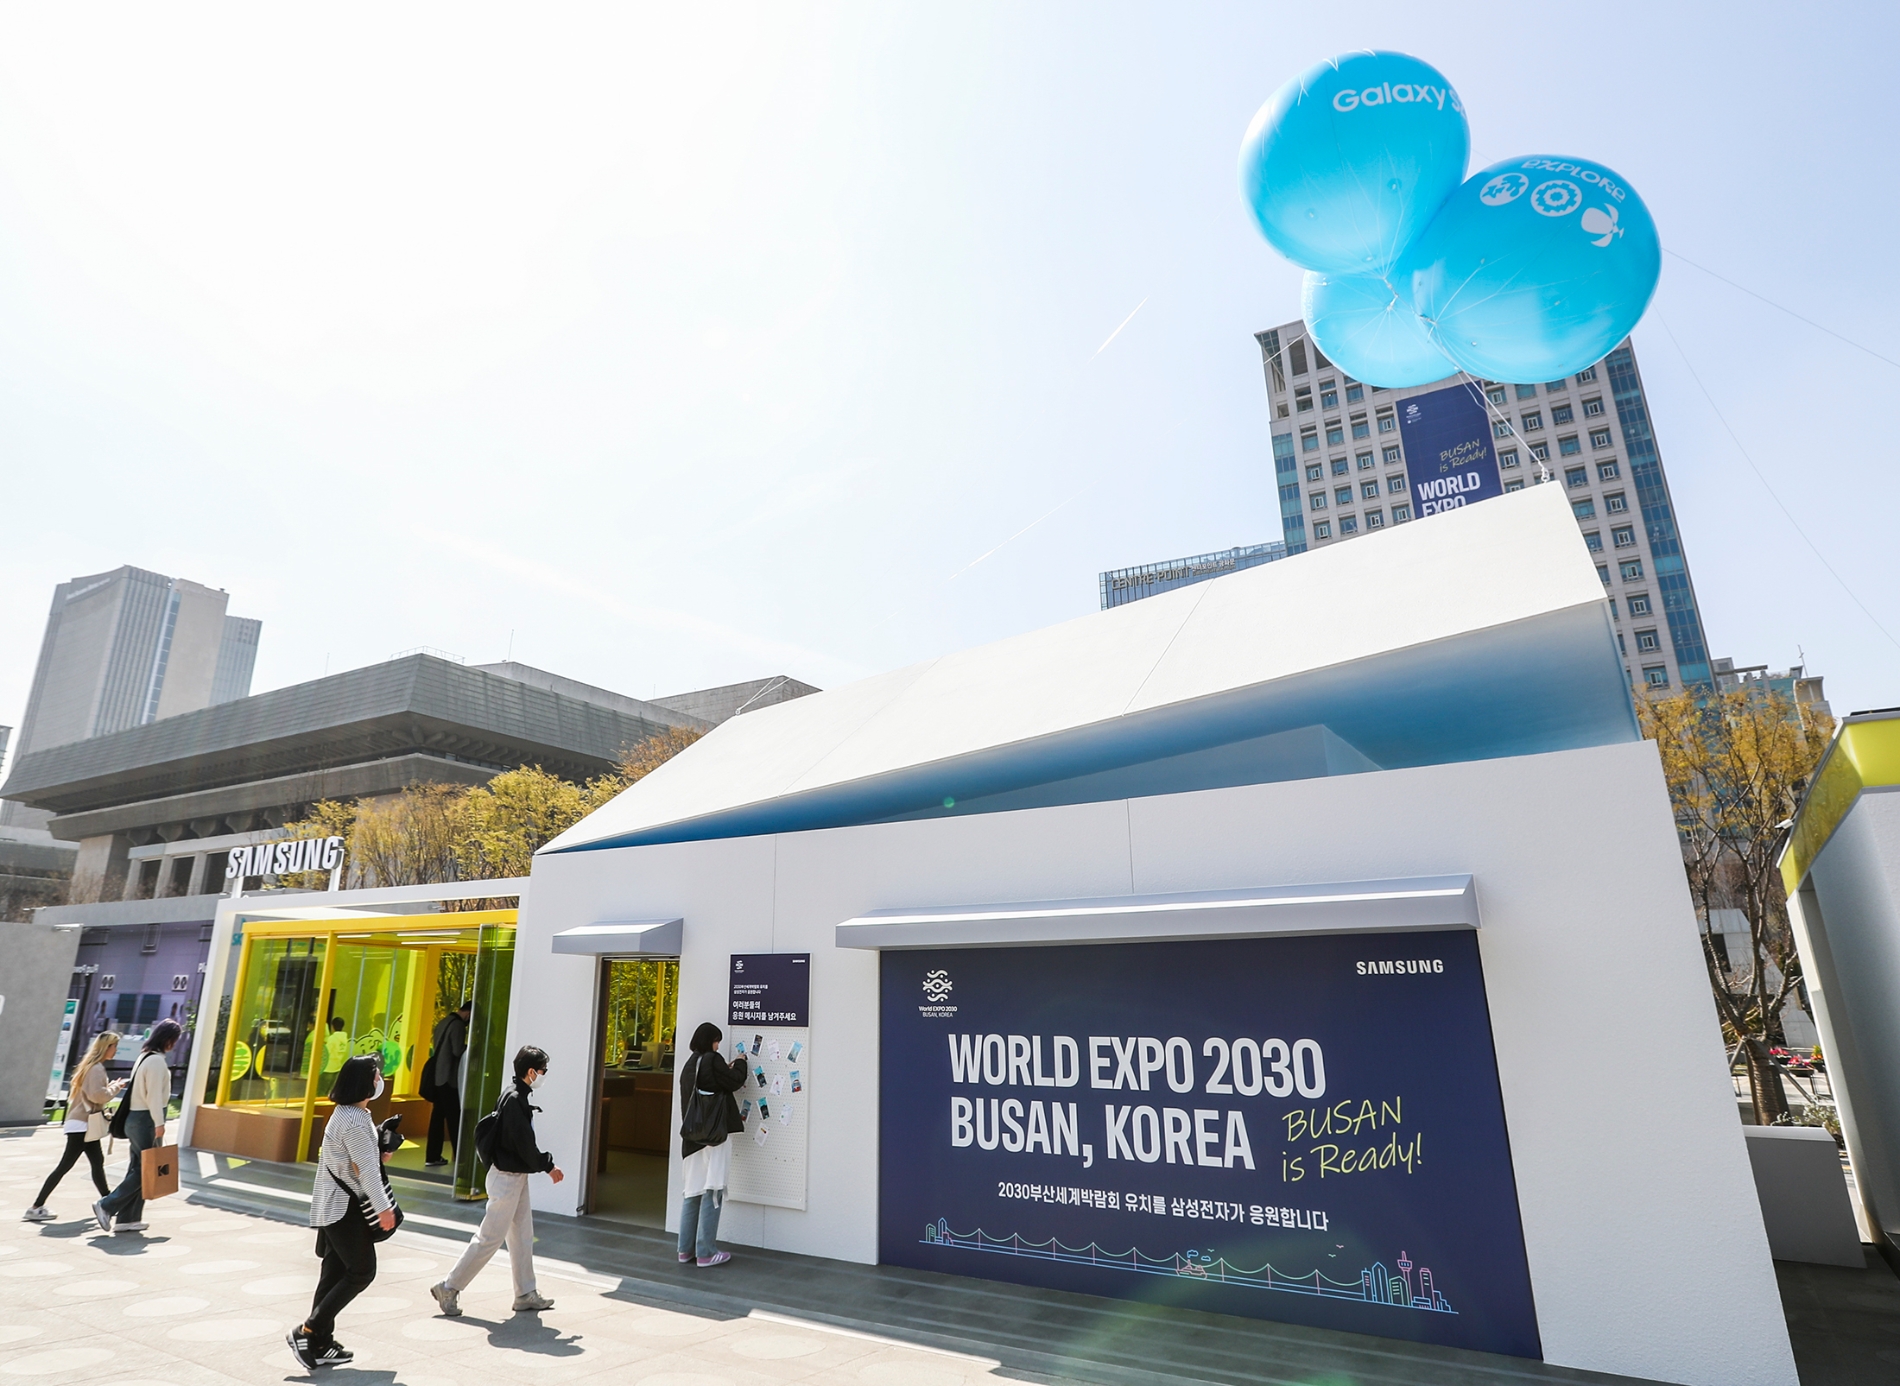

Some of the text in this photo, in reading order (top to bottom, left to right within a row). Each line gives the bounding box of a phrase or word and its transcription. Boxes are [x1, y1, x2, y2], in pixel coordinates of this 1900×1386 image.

[1333, 82, 1446, 112] Galaxy
[1439, 438, 1480, 462] BUSAN
[1439, 446, 1487, 473] is Ready!
[1417, 471, 1481, 501] WORLD
[225, 836, 342, 879] SAMSUNG
[1356, 959, 1444, 975] SAMSUNG
[948, 1033, 1327, 1099] WORLD EXPO 2030
[951, 1096, 1256, 1170] BUSAN, KOREA
[1281, 1096, 1401, 1142] BUSAN
[1282, 1131, 1422, 1182] is Ready!
[997, 1181, 1329, 1232] 2030부산세계박람회 유치를 삼성전자가 응원합니다
